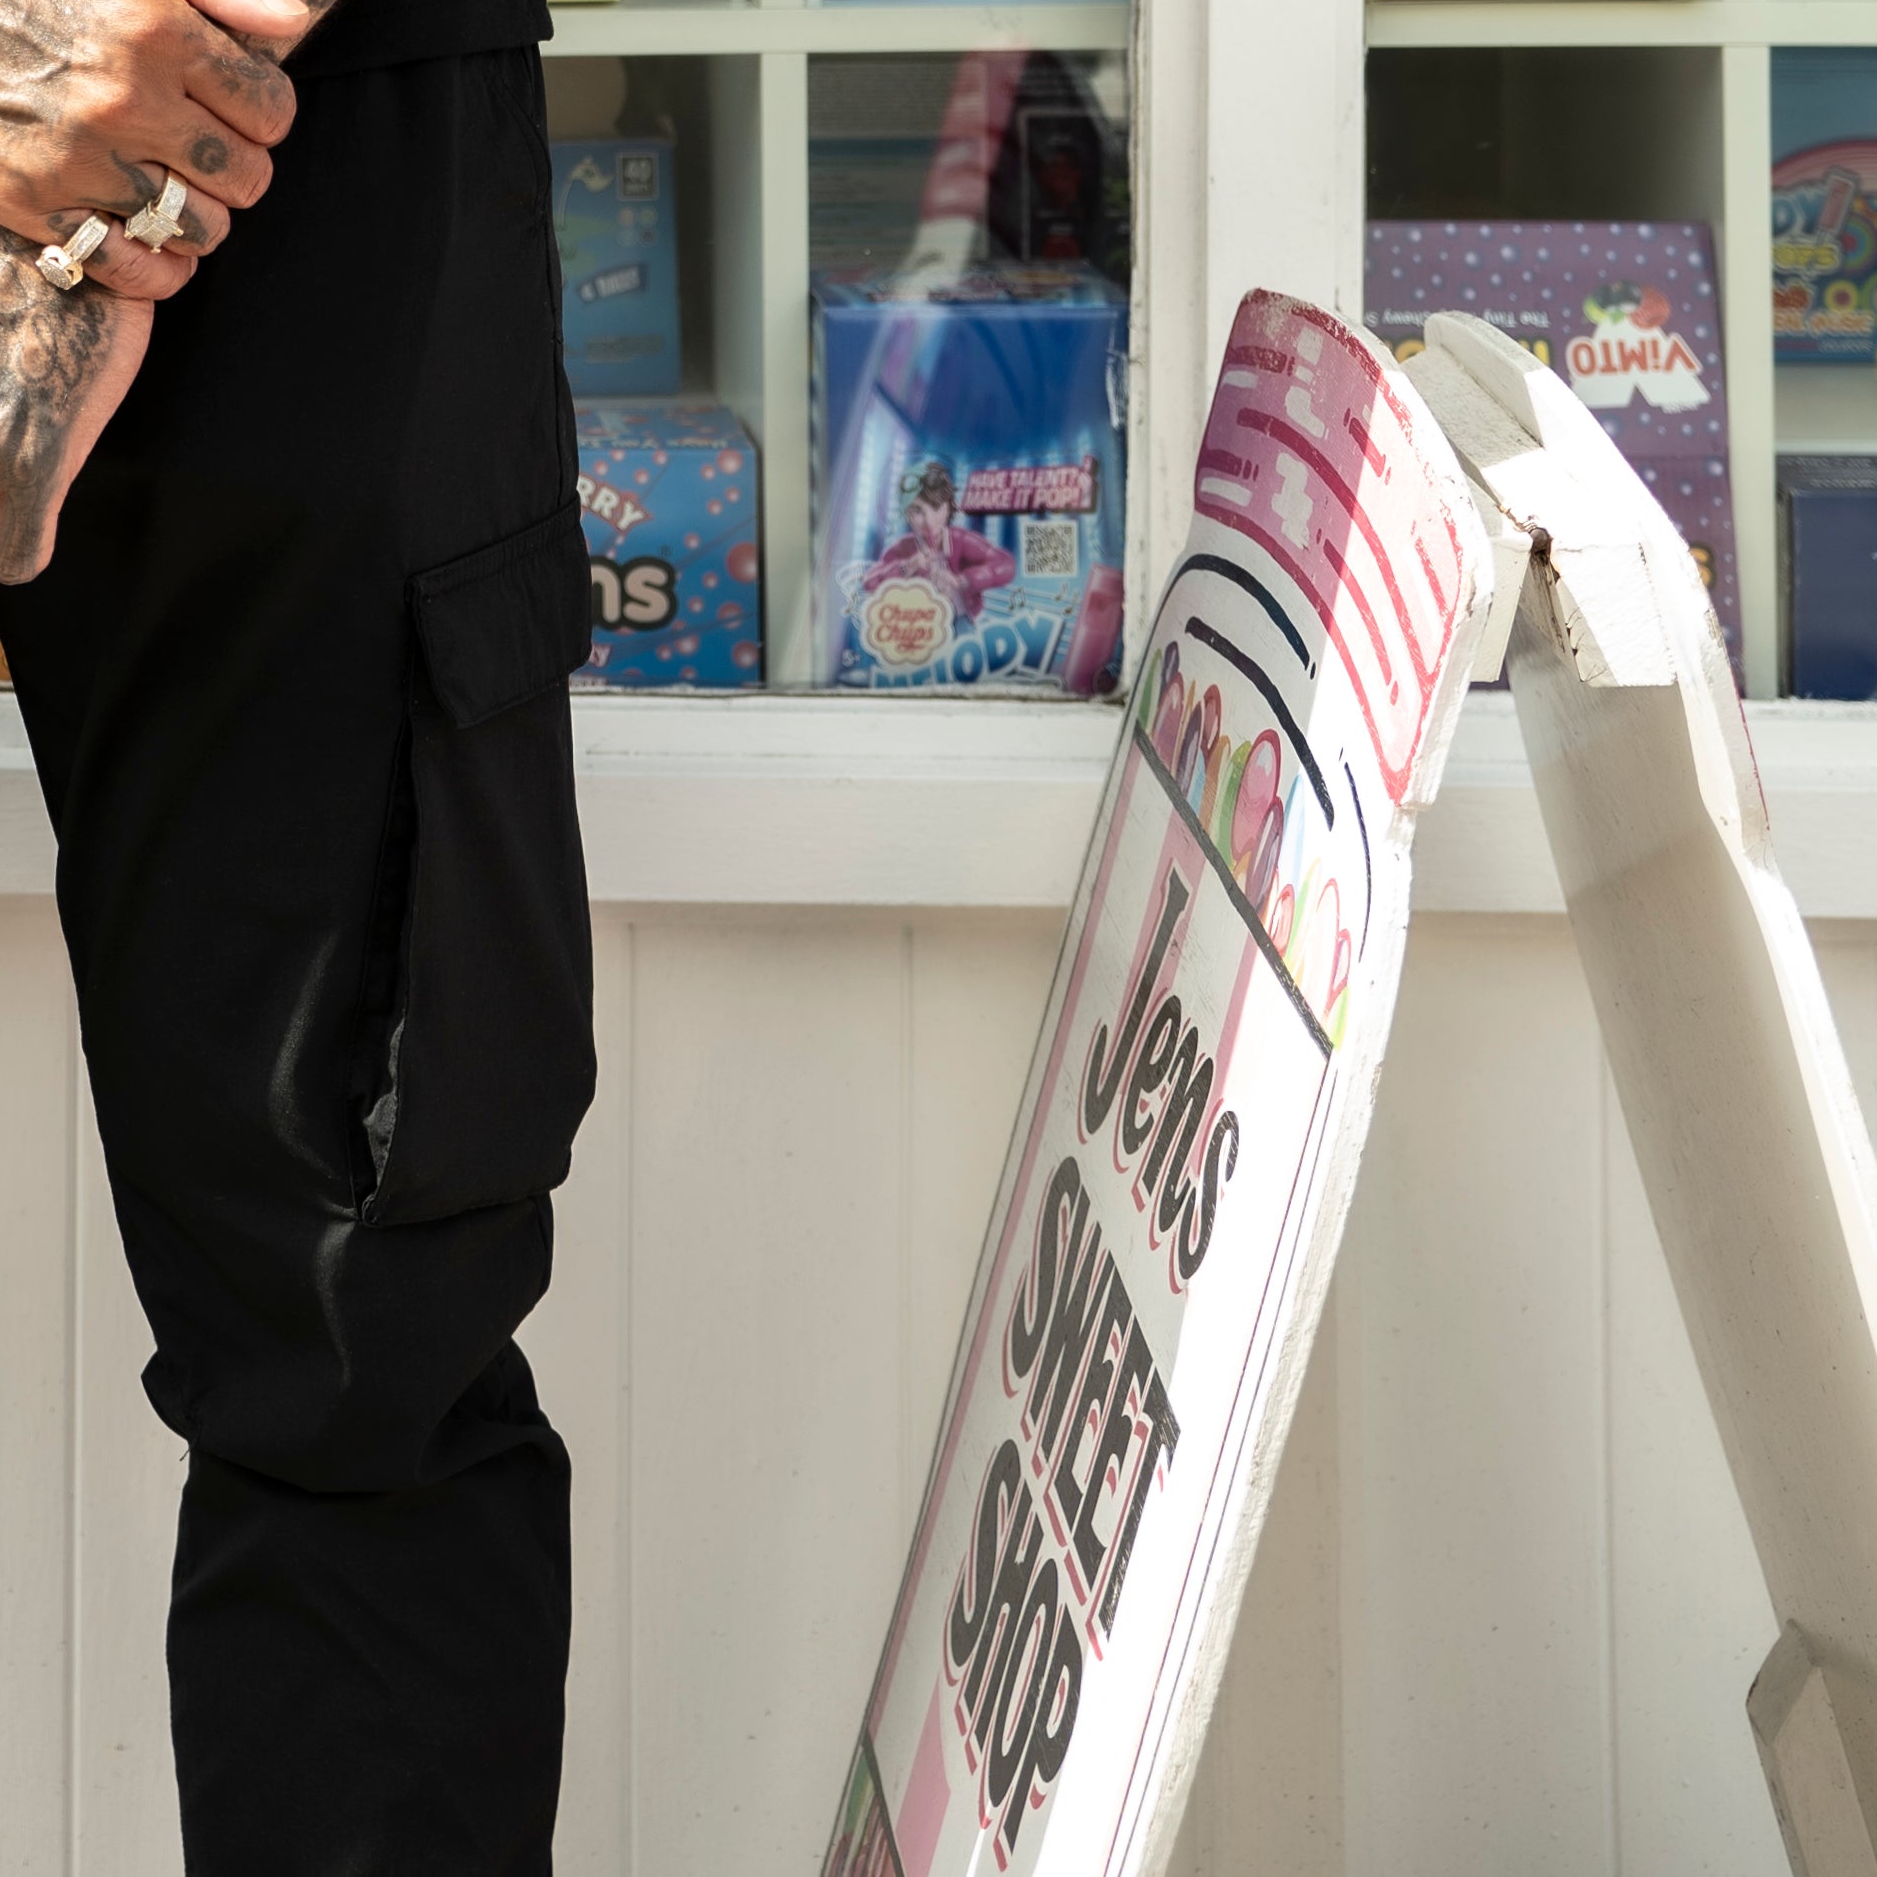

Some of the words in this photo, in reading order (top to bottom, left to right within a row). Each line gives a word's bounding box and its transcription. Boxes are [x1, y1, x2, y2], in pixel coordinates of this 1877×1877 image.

[967, 472, 1007, 488] HAVE
[1009, 469, 1080, 487] TALENT?
[965, 489, 1011, 509] MAKE
[1013, 489, 1032, 507] IT
[1032, 488, 1080, 507] POP!
[878, 604, 936, 623] Chupa
[875, 622, 936, 643] Chups
[1083, 868, 1241, 1286] Jens
[1013, 1156, 1183, 1642] SWEET
[951, 1439, 1081, 1855] SHOP
